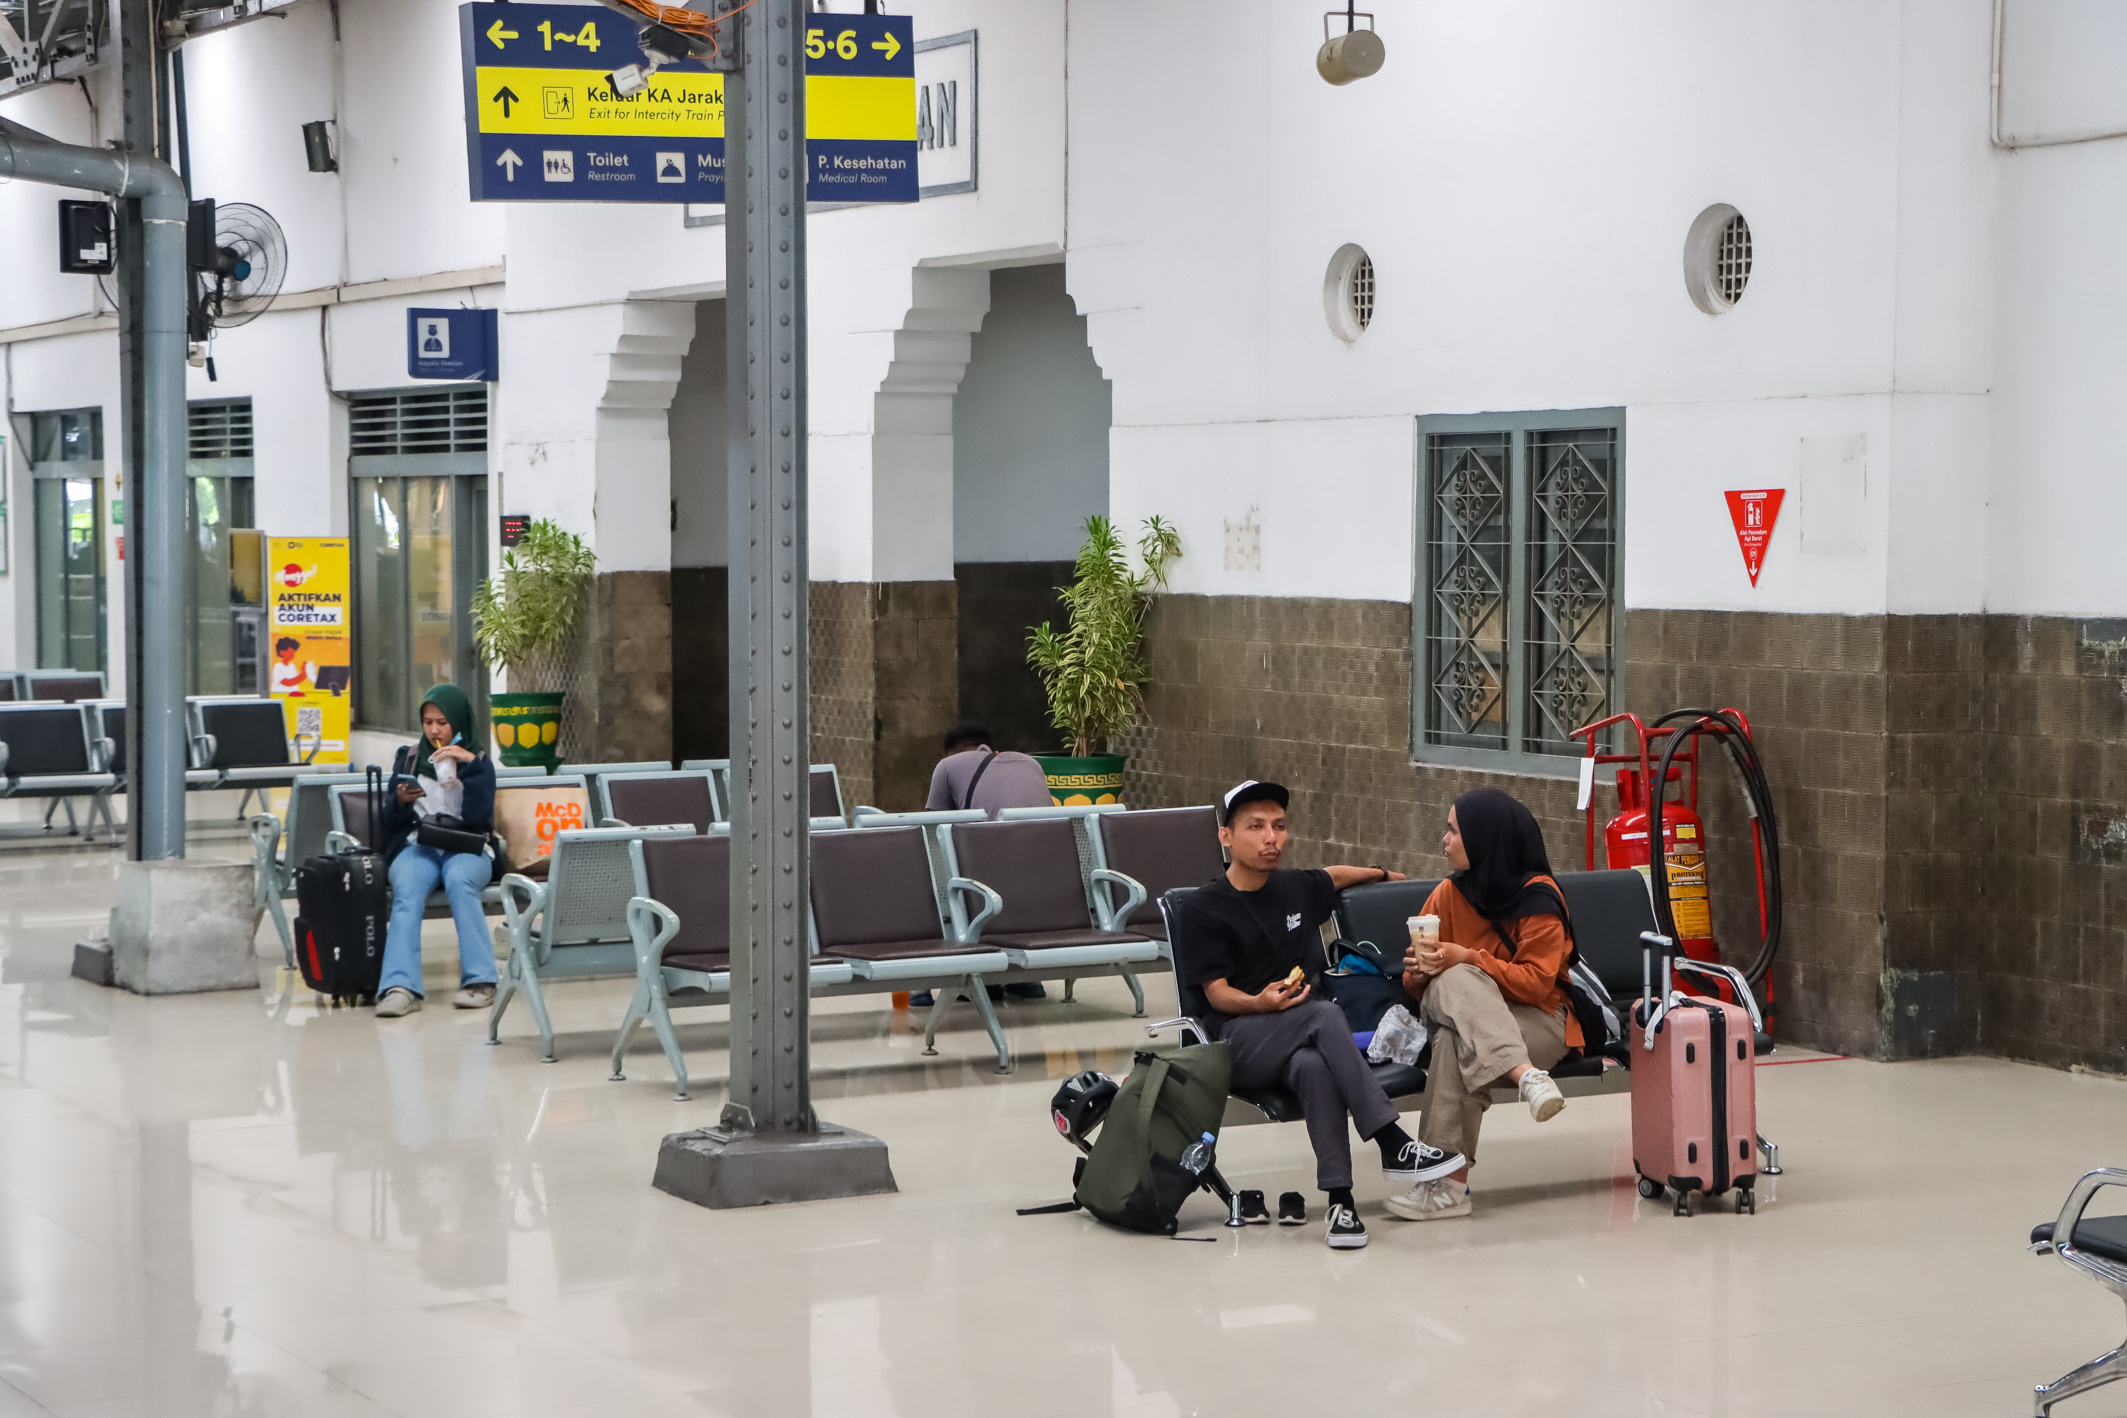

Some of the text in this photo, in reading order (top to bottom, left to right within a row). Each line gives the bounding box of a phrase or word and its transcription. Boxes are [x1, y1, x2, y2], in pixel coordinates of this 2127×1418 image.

[648, 88, 673, 103] KA
[677, 88, 724, 104] Jarak
[589, 107, 611, 119] Exit
[614, 107, 631, 119] for
[634, 109, 682, 122] Intercity
[685, 109, 714, 121] Train
[917, 80, 957, 151] AN
[586, 152, 629, 167] Toilet
[818, 155, 907, 169] P. Kesehatan
[587, 170, 636, 181] Restroom
[698, 171, 725, 184] Prayi
[818, 173, 888, 183] Medical Room
[278, 593, 342, 602] AKTIFKAN
[278, 603, 314, 612] AKUN
[278, 613, 337, 622] CORETAX
[535, 802, 582, 818] McD
[362, 856, 375, 885] OLO
[365, 915, 376, 958] POLO
